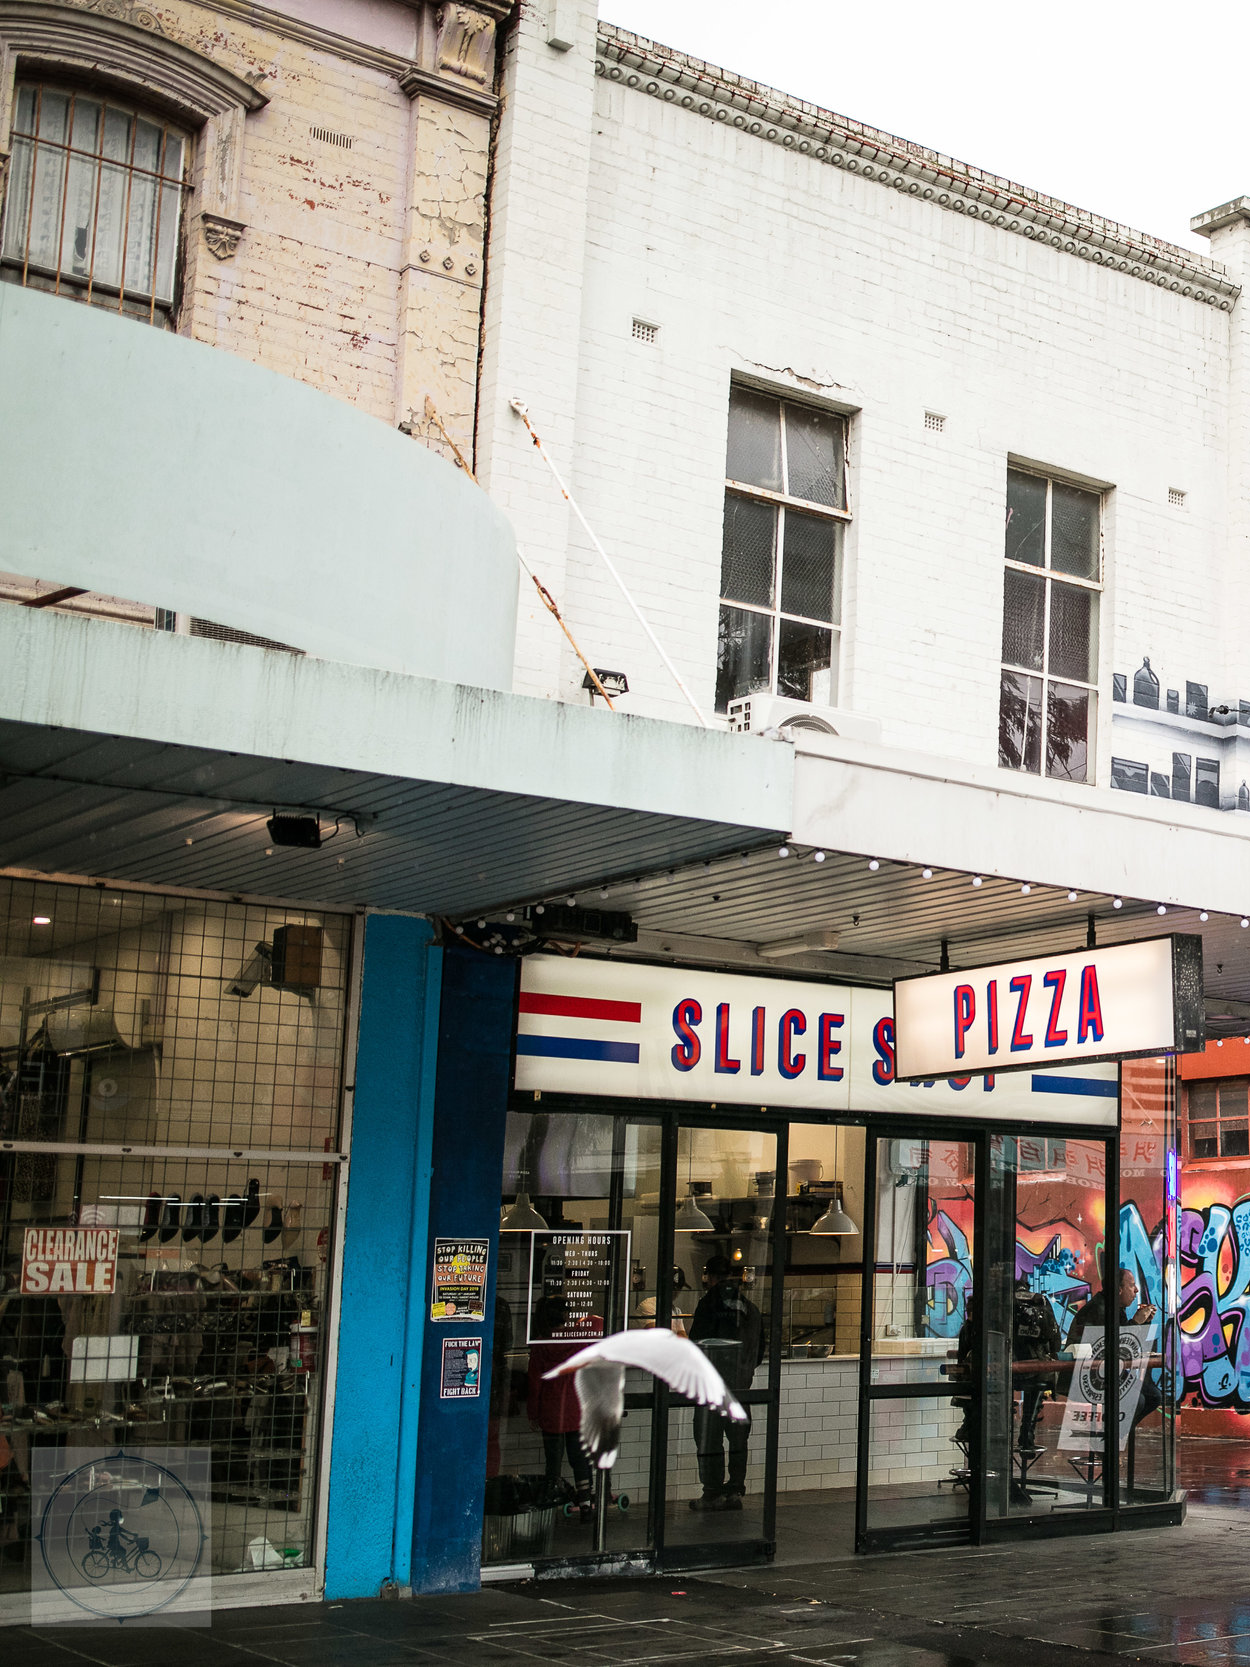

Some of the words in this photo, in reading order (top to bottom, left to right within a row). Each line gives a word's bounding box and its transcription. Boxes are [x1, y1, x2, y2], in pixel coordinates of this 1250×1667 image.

[953, 964, 1105, 1060] PIZZA
[670, 998, 845, 1082] SLICE
[26, 1229, 117, 1262] CLEARANCE
[552, 1236, 585, 1245] OPENING
[587, 1236, 611, 1245] HOURS
[437, 1246, 456, 1254] STOP
[457, 1245, 487, 1255] KILLING
[438, 1255, 454, 1263] OUR
[457, 1255, 484, 1263] PEOPLE
[437, 1265, 457, 1273] STOP
[459, 1265, 484, 1273] TAKING
[25, 1262, 115, 1293] SALE
[454, 1274, 482, 1283] FUTURE
[443, 1387, 460, 1397] FIGHT
[461, 1387, 477, 1395] BACK
